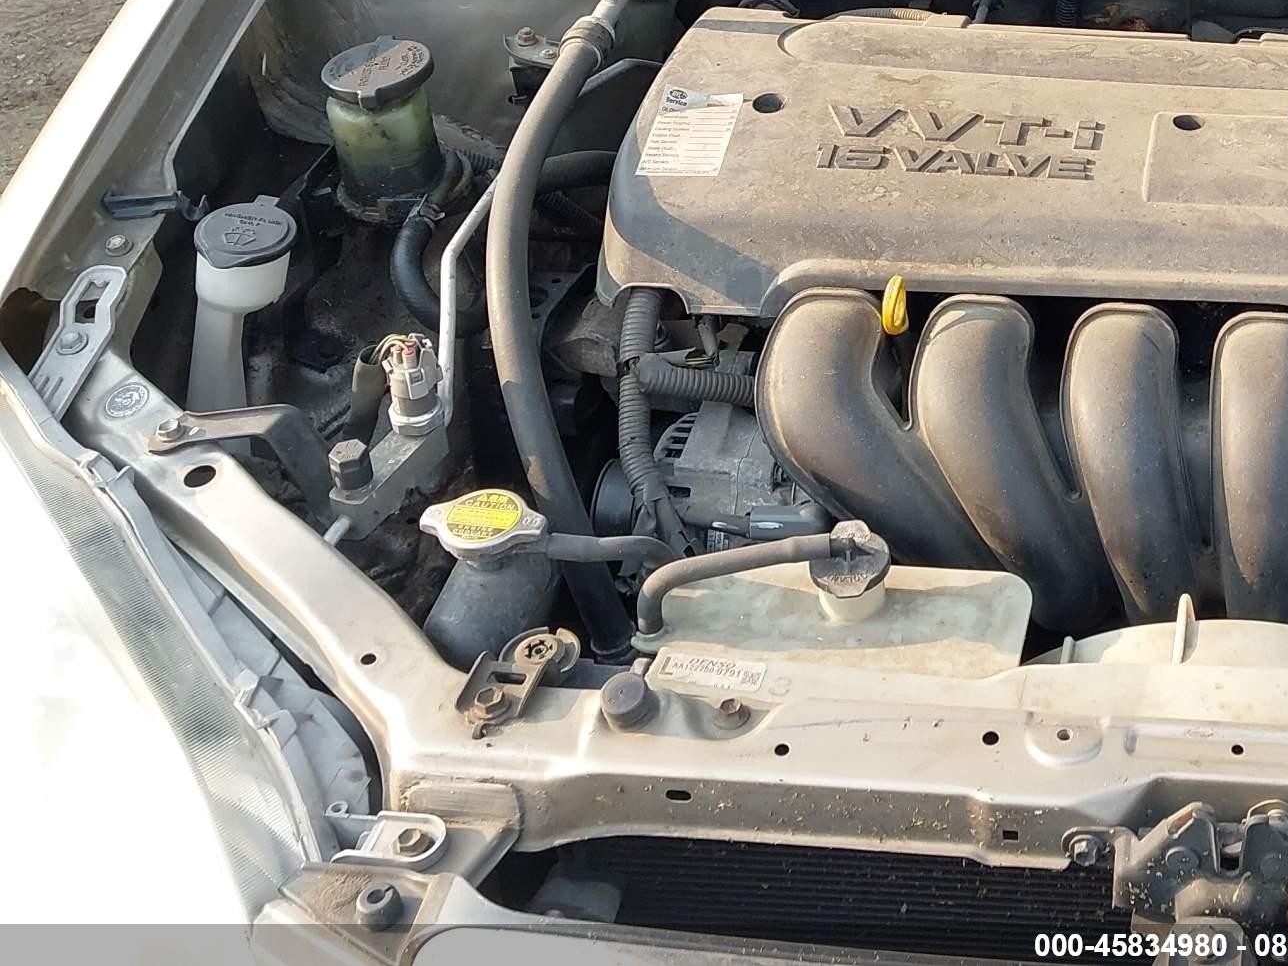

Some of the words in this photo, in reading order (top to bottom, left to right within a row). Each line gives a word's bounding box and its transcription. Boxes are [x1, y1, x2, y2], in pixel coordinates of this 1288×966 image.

[829, 104, 1106, 151] VVT-i
[465, 499, 515, 511] CAUTION
[689, 658, 737, 669] DENSO
